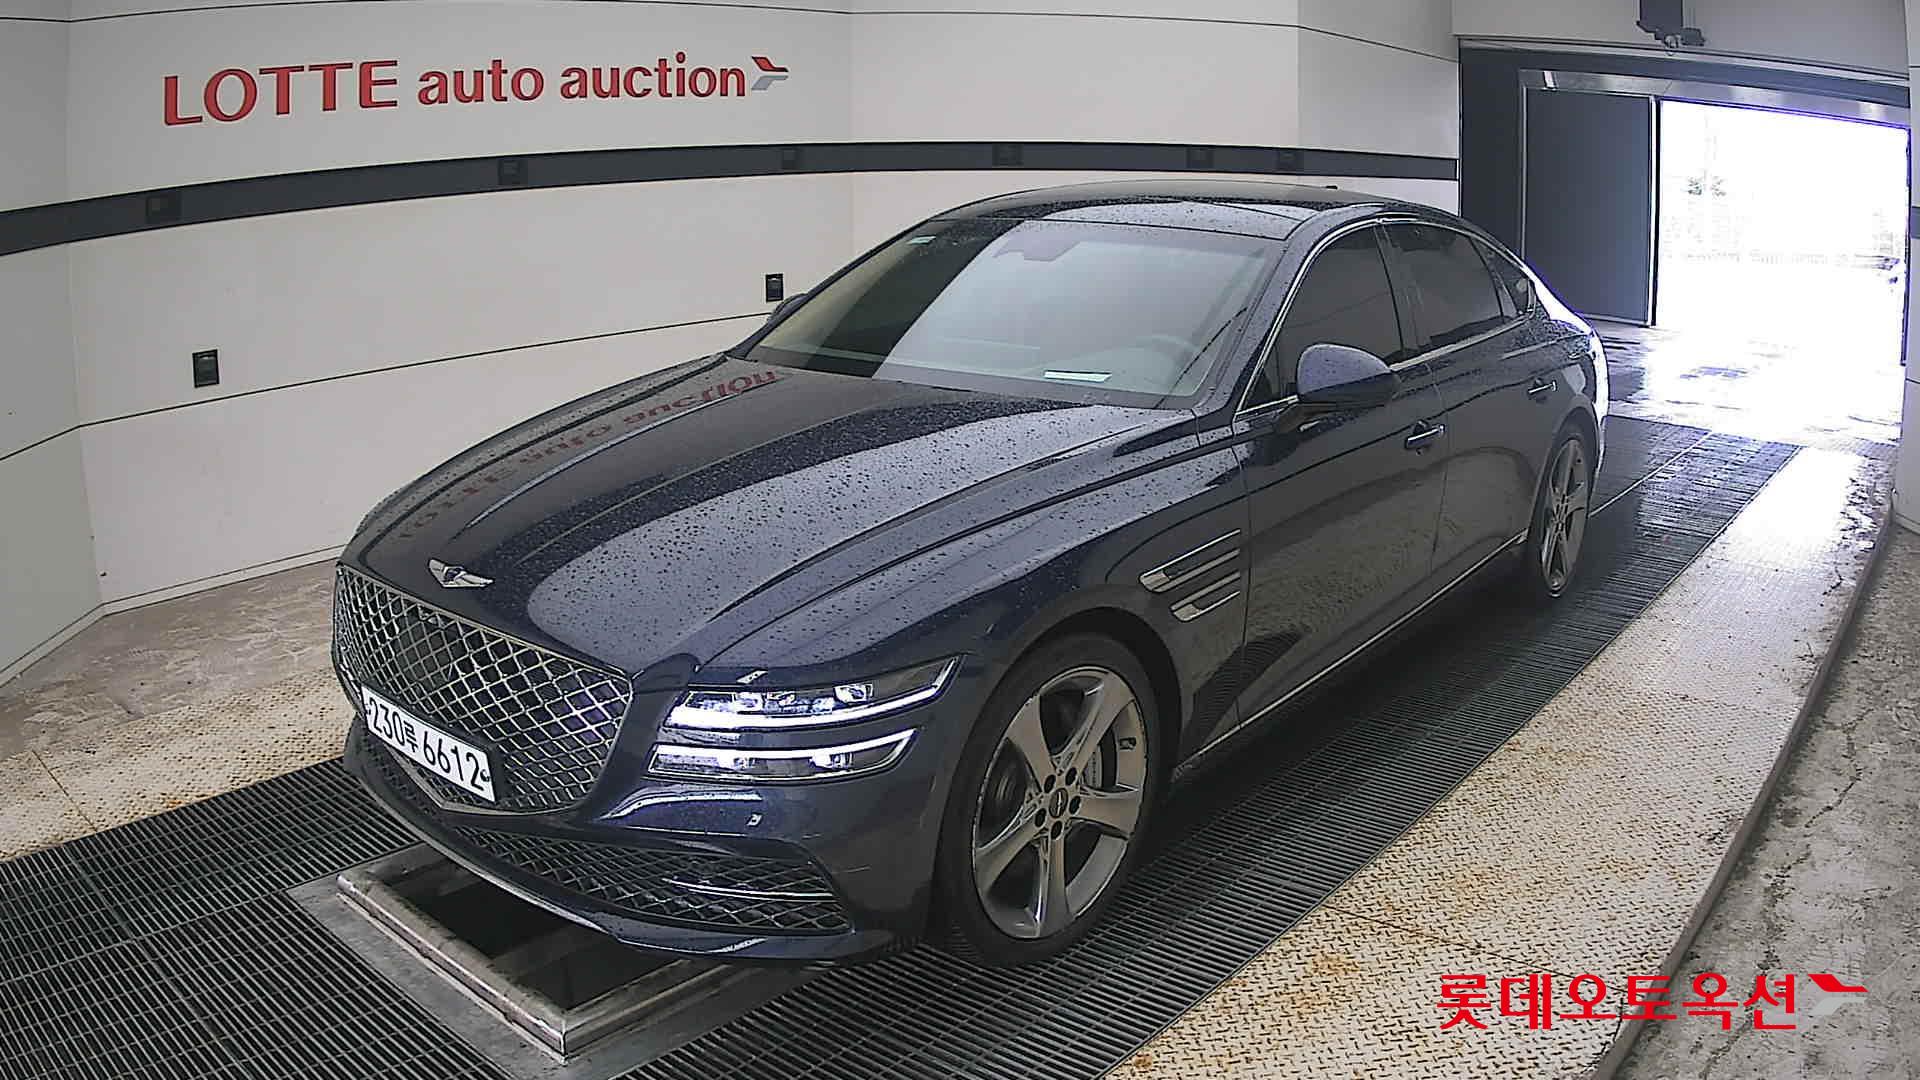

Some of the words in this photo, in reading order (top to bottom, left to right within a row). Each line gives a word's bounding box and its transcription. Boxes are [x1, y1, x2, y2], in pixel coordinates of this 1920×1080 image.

[163, 59, 398, 126] LOTTE
[417, 59, 545, 105] auto
[560, 51, 746, 99] auction
[423, 730, 485, 791] 6612
